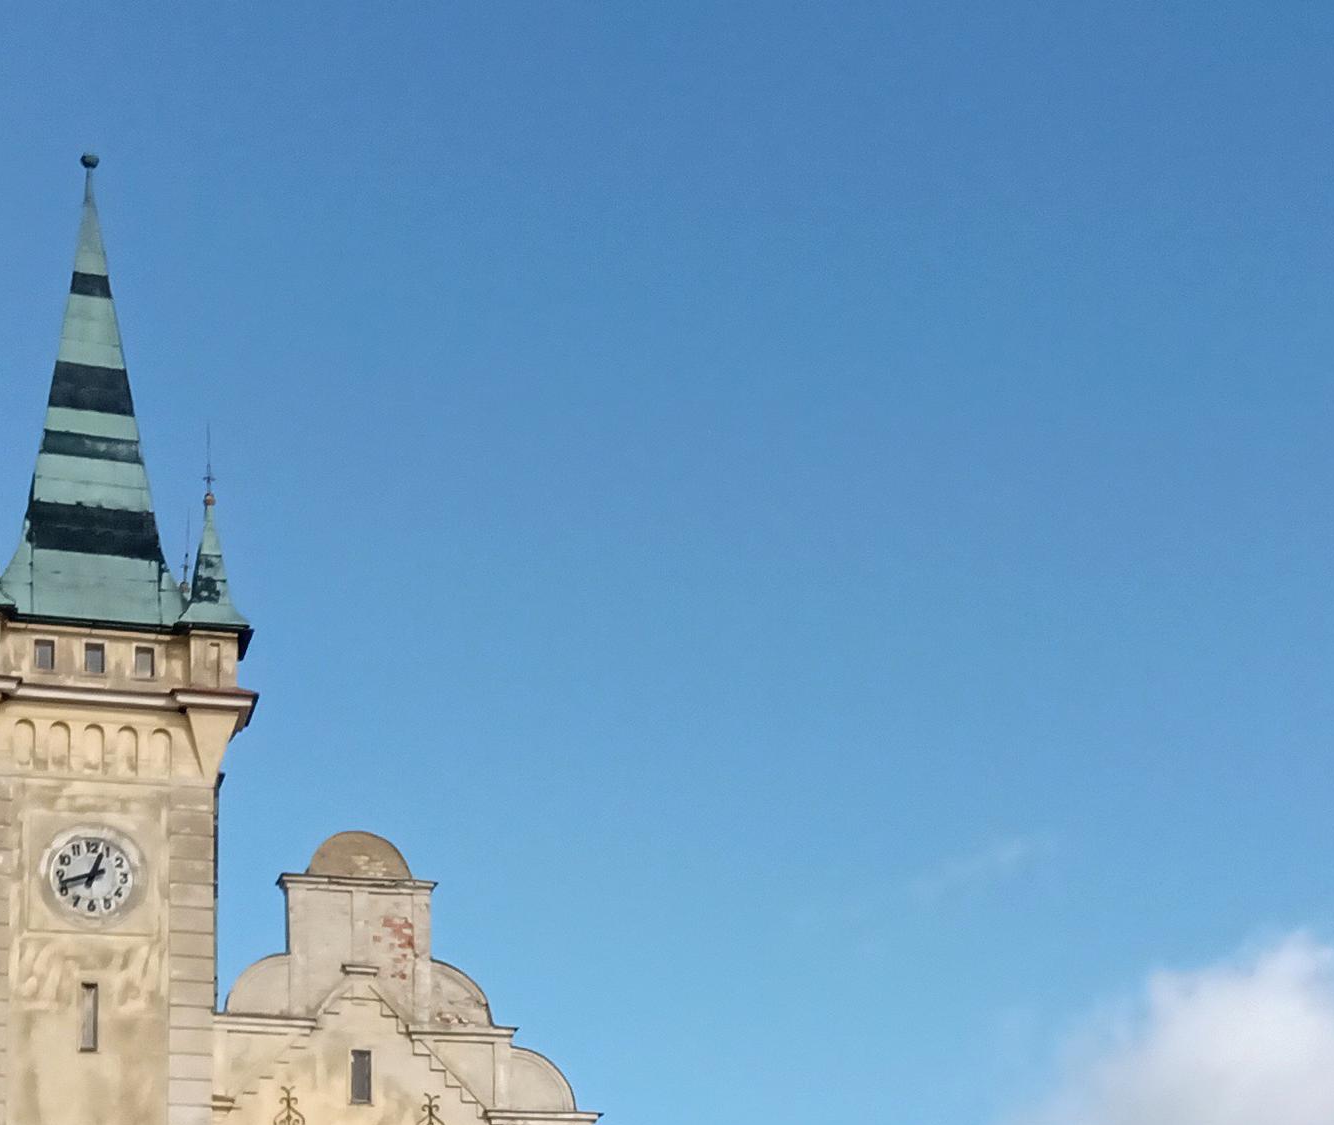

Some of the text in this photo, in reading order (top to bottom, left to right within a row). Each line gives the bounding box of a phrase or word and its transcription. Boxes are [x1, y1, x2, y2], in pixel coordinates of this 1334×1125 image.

[72, 844, 80, 856] 11
[86, 842, 98, 853] 12
[59, 854, 71, 866] 10
[115, 857, 124, 868] 2
[120, 872, 128, 884] 3
[114, 887, 122, 898] 4
[72, 896, 81, 907] 7
[87, 900, 96, 912] 6
